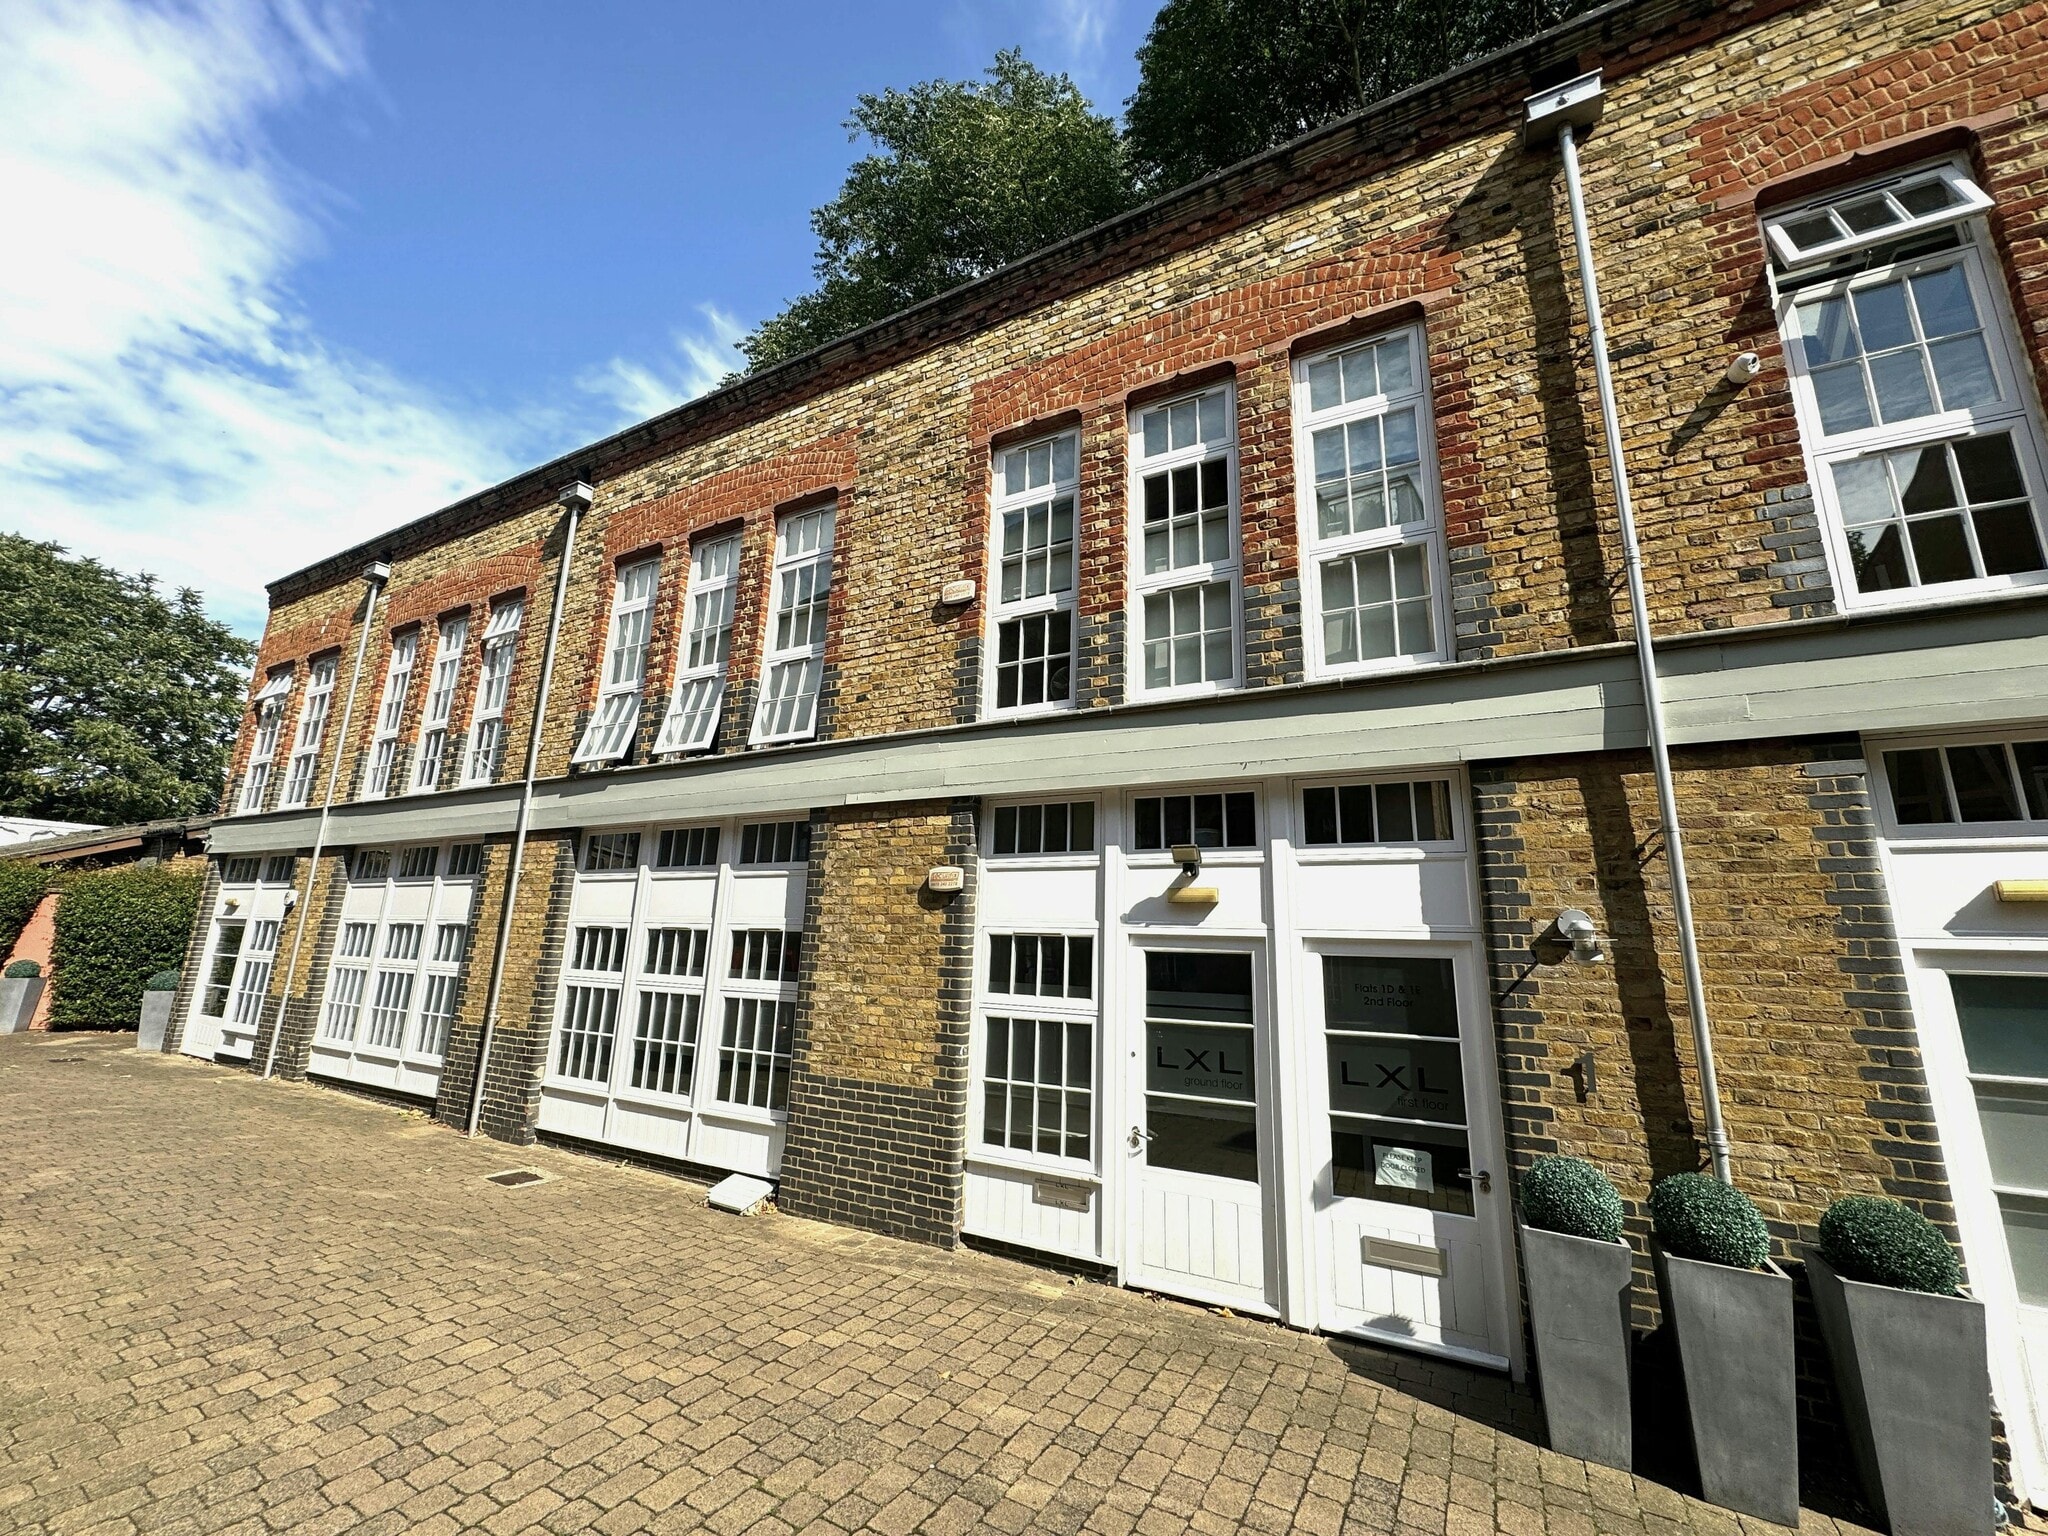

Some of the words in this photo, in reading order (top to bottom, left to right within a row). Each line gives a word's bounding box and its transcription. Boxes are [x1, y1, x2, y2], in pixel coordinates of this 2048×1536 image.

[1355, 983, 1378, 993] Flats
[1381, 984, 1395, 994] 1D
[1398, 985, 1407, 994] &
[1364, 996, 1384, 1006] 2nd
[1387, 997, 1414, 1008] Floor
[1157, 1046, 1243, 1075] LXL
[1184, 1076, 1218, 1087] ground
[1221, 1078, 1243, 1090] floor
[1341, 1061, 1449, 1094] LXL
[1398, 1096, 1418, 1108] first
[1423, 1097, 1449, 1110] floor
